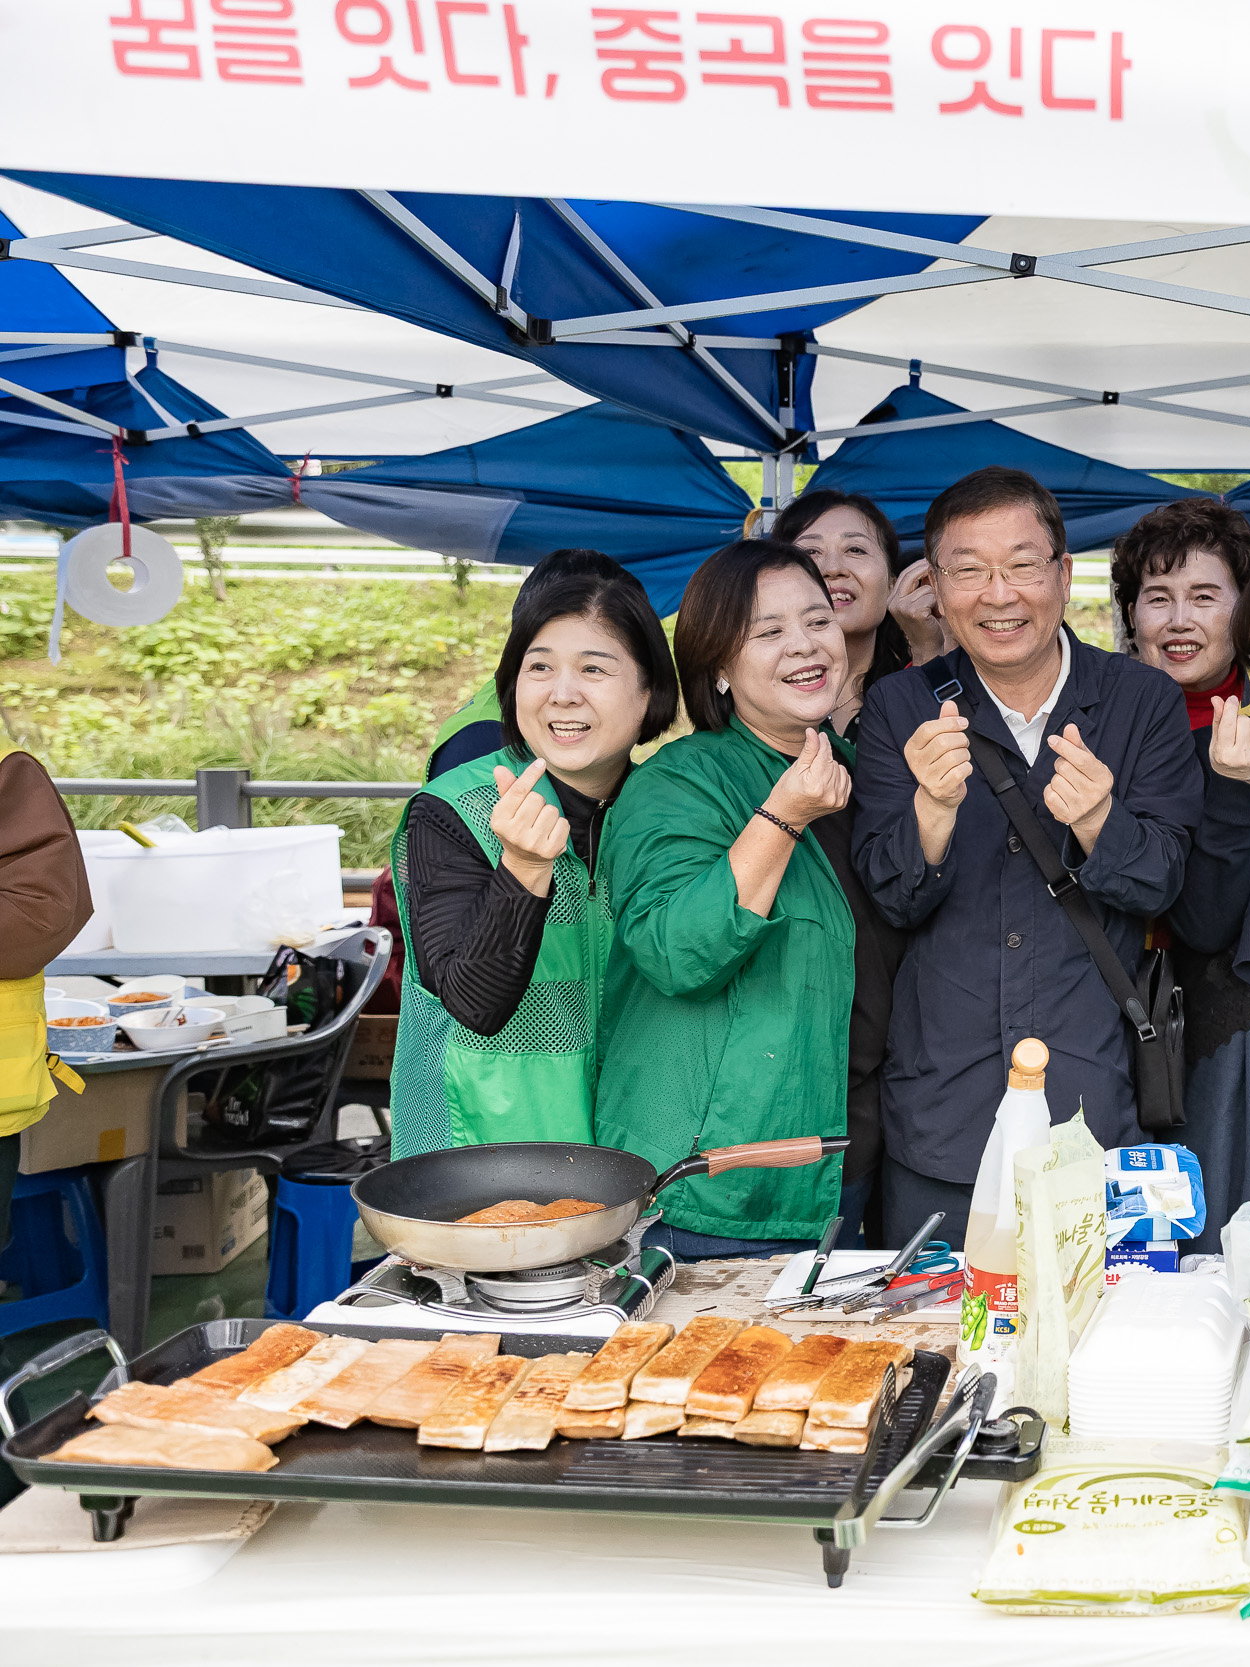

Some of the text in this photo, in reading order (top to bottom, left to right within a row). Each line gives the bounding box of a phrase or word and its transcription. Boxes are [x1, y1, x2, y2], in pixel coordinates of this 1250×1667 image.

[109, 0, 1133, 120] 꿈을 잇다, 중곡을 잇다
[1023, 1490, 1224, 1515] 곤드레나물 전병
